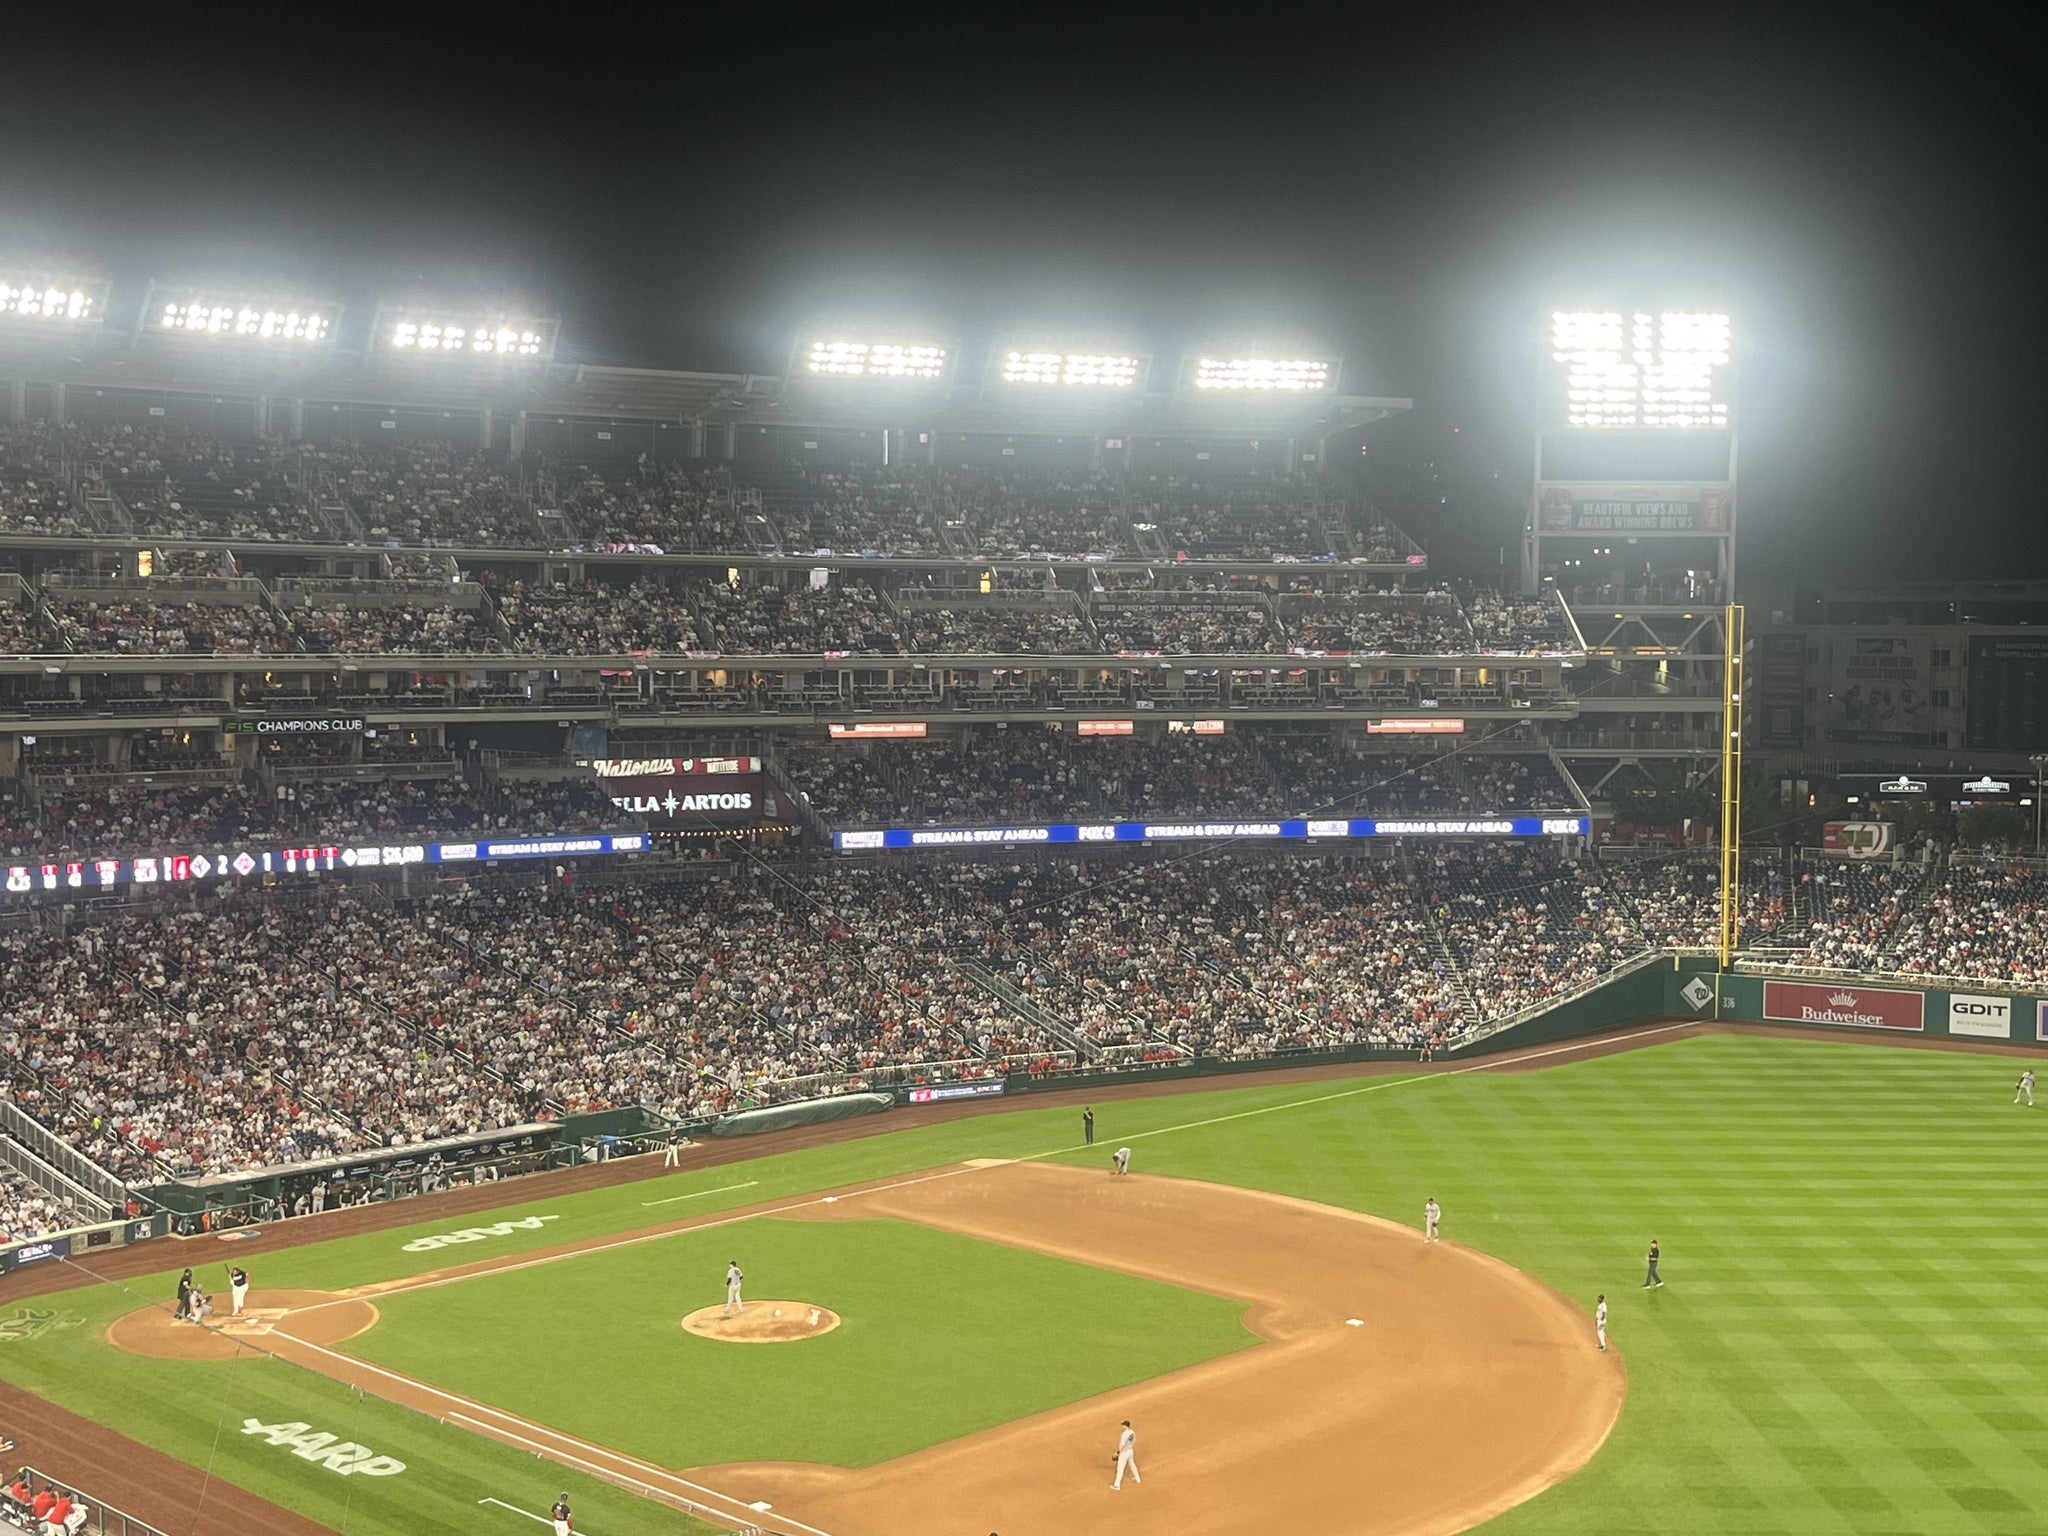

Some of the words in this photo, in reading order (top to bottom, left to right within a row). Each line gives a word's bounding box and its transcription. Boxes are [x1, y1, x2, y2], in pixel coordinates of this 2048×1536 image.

[1583, 503, 1632, 516] BEAUTIFUL
[1636, 503, 1666, 516] VIEWS
[1668, 503, 1688, 515] AND
[1578, 516, 1610, 528] AWARD
[1613, 516, 1657, 528] WINNING
[1660, 516, 1693, 528] BREWS
[1099, 604, 1116, 612] NEED
[1160, 604, 1176, 612] TEXT
[257, 720, 329, 732] CHAMPIONS
[332, 720, 363, 731] CLUB
[593, 758, 676, 777] Nationals
[681, 793, 752, 811] ARTOIS
[1078, 826, 1104, 840] FOX
[1104, 826, 1116, 839] 5
[1144, 826, 1194, 837] STREAM
[1194, 825, 1204, 836] &
[1204, 824, 1235, 836] STAY
[1234, 824, 1280, 835] AHEAD
[1375, 822, 1425, 834] STREAM
[1426, 822, 1436, 832] &
[1436, 822, 1466, 832] STAY
[1466, 822, 1513, 832] AHEAD
[1542, 820, 1567, 833] FOX
[1568, 820, 1579, 832] 5
[912, 832, 963, 844] STREAM
[964, 831, 973, 842] &
[973, 830, 1004, 842] STAY
[1004, 828, 1049, 841] AHEAD
[488, 844, 532, 855] STREAM
[532, 842, 539, 854] &
[540, 842, 564, 854] STAY
[564, 840, 601, 851] AHEAD
[612, 837, 630, 850] FOX
[631, 836, 642, 848] 5
[218, 854, 228, 874] 2
[262, 852, 272, 872] 1
[178, 860, 186, 880] 4
[1952, 1003, 2008, 1016] GDIT
[135, 1231, 152, 1240] MLB
[240, 1418, 407, 1477] AARP
